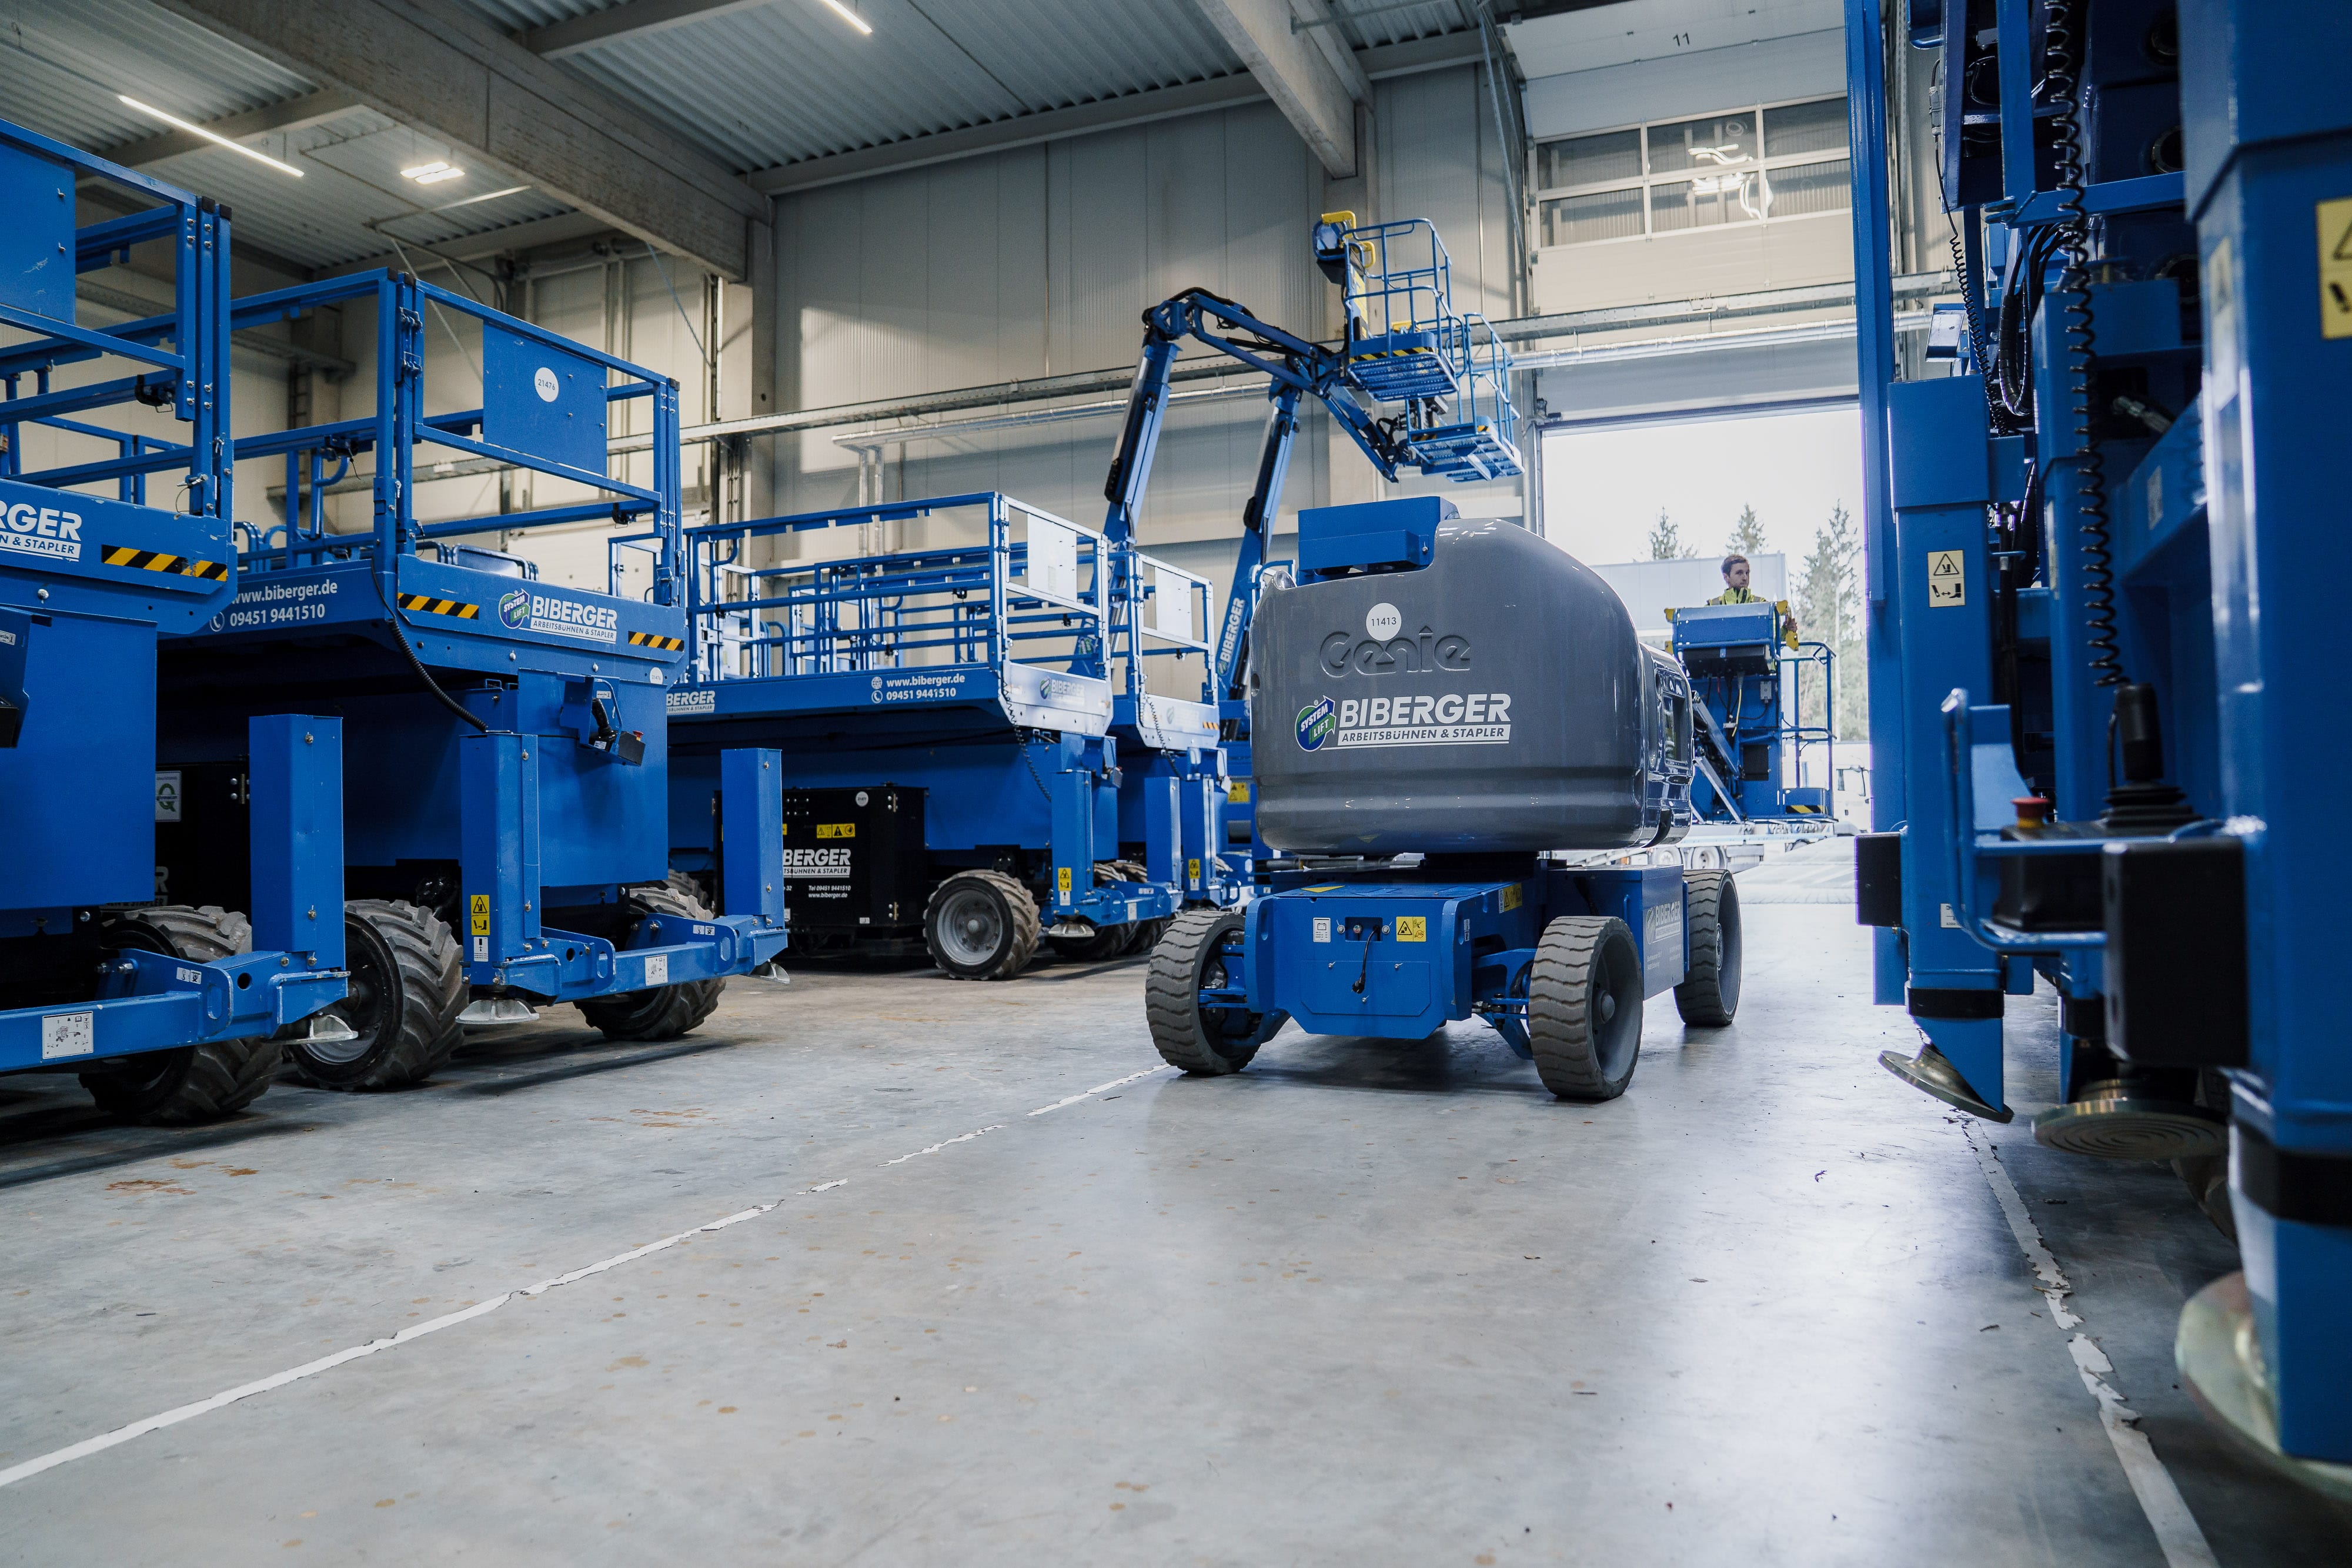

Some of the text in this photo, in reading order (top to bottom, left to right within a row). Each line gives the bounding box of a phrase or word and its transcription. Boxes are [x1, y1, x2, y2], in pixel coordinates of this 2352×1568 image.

[1673, 32, 1690, 47] 11
[537, 378, 556, 390] 21476
[12, 537, 21, 546] &
[24, 539, 75, 554] STAPLER
[504, 594, 525, 613] SYSTEM
[513, 606, 526, 619] LIFT
[532, 596, 617, 629] BIBERGER
[230, 604, 325, 627] 09451 9441510
[1371, 617, 1397, 627] 11413
[533, 619, 584, 634] ARBEITSBÜHNEN
[591, 629, 614, 638] STAPLER
[1220, 597, 1245, 663] BIBERGER
[1319, 625, 1471, 678] Genie
[886, 673, 965, 687] www.biberger.de
[666, 690, 716, 706] BERGER
[886, 688, 956, 700] 09451 9441510
[1300, 703, 1329, 732] SYSTEM
[1339, 693, 1511, 728] BIBERGER
[1313, 718, 1329, 738] LIFT
[1341, 727, 1504, 742] ARBEITSBÜHNEN & STAPLER
[783, 848, 851, 866] BERGER
[1655, 901, 1681, 927] BIBERGER
